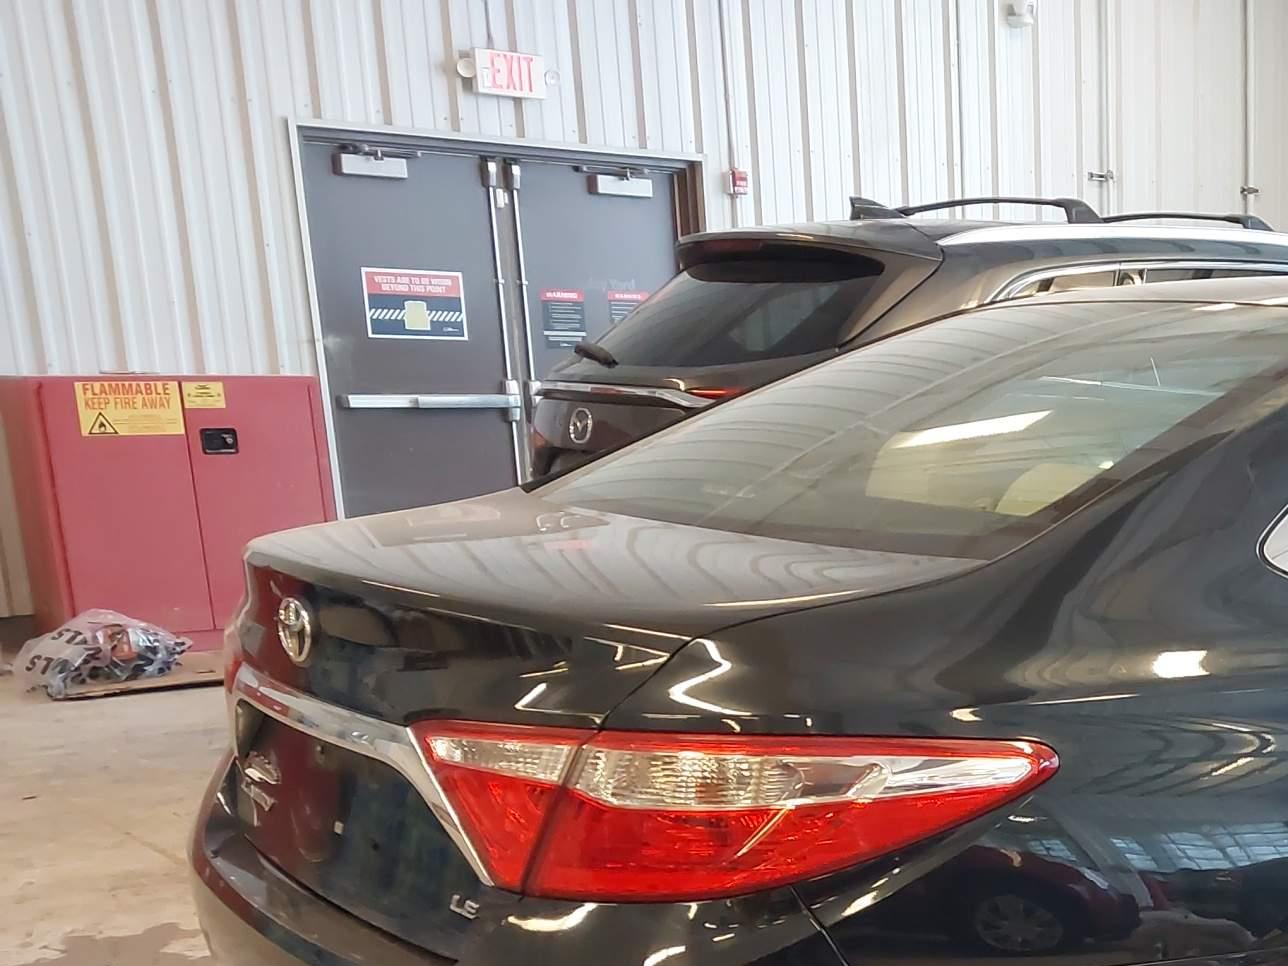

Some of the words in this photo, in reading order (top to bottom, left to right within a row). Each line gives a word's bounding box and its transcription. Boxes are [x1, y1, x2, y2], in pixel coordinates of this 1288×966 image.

[489, 52, 534, 93] EXIT
[82, 382, 171, 396] FLAMMABLE
[84, 397, 110, 410] KEEP
[114, 397, 138, 410] FIRE
[141, 397, 172, 410] AWAY
[450, 894, 480, 920] LE
